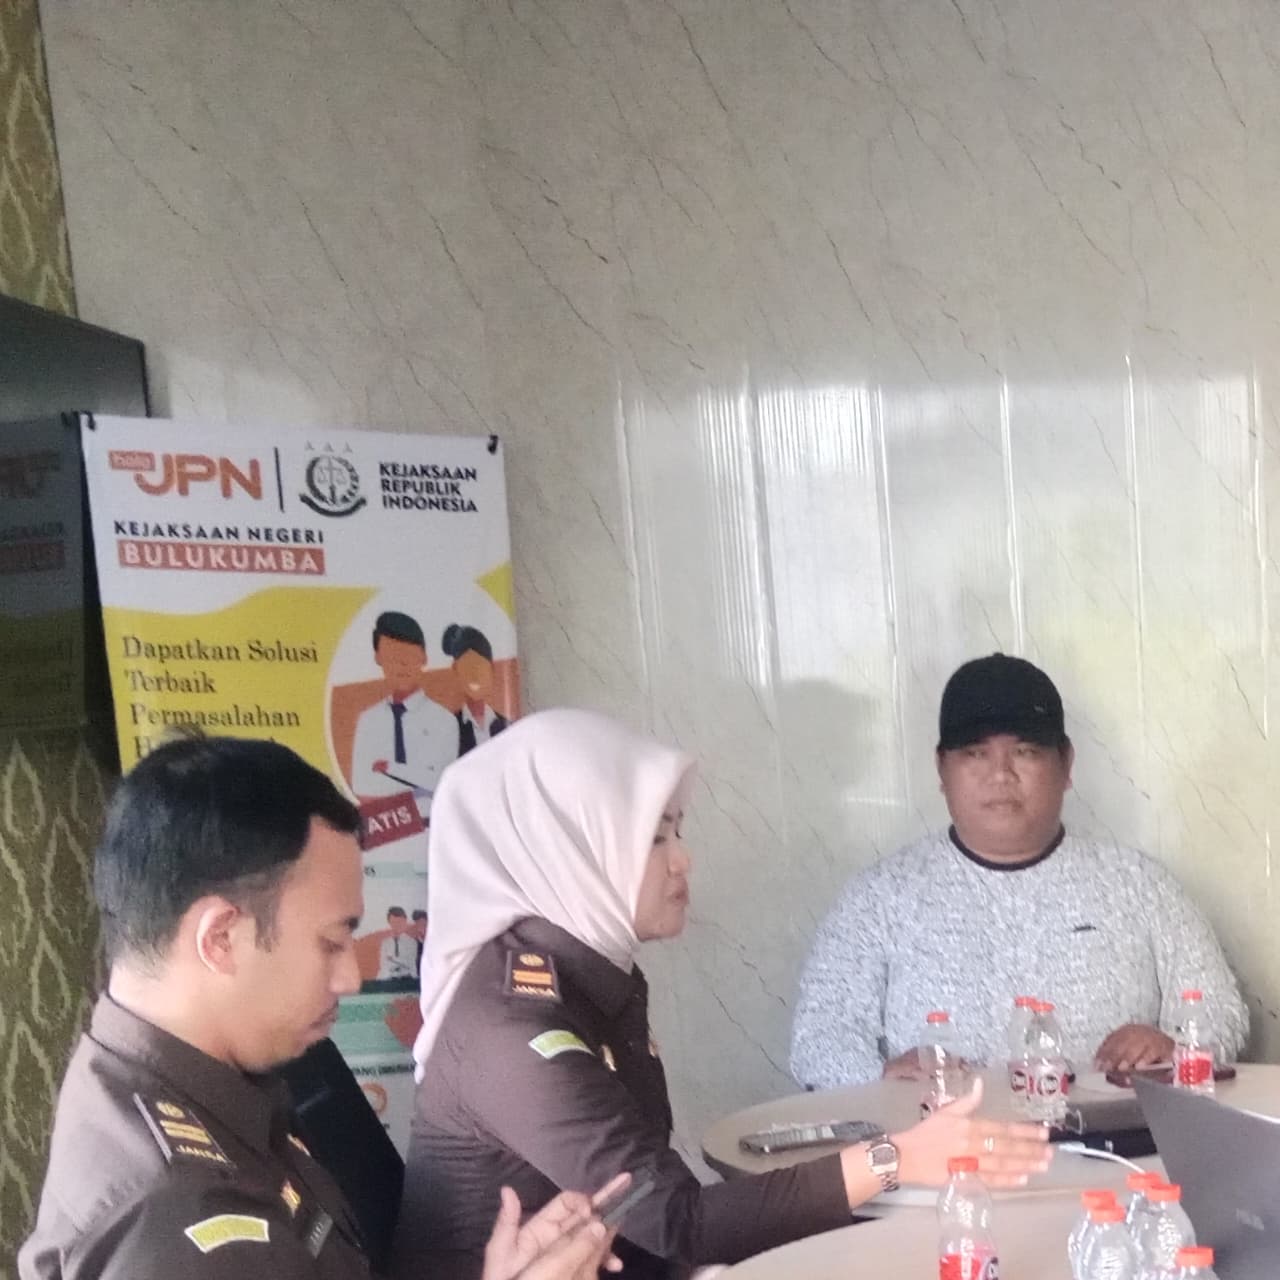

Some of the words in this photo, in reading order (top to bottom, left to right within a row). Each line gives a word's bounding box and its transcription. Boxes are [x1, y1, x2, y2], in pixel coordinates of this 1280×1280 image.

[134, 453, 263, 500] JPN
[379, 461, 477, 481] KEJAKSAAN
[381, 478, 462, 496] REPUBLIK
[383, 495, 479, 513] INDONESIA
[114, 520, 240, 540] KEJAKSAAN
[247, 526, 324, 544] NEGERI
[123, 542, 320, 573] BULUKUMBA
[122, 635, 241, 663] Dapatkan
[246, 637, 319, 663] Solusi
[124, 669, 216, 694] Terbaik
[130, 702, 300, 728] Permasalahan
[368, 805, 412, 835] ATIS
